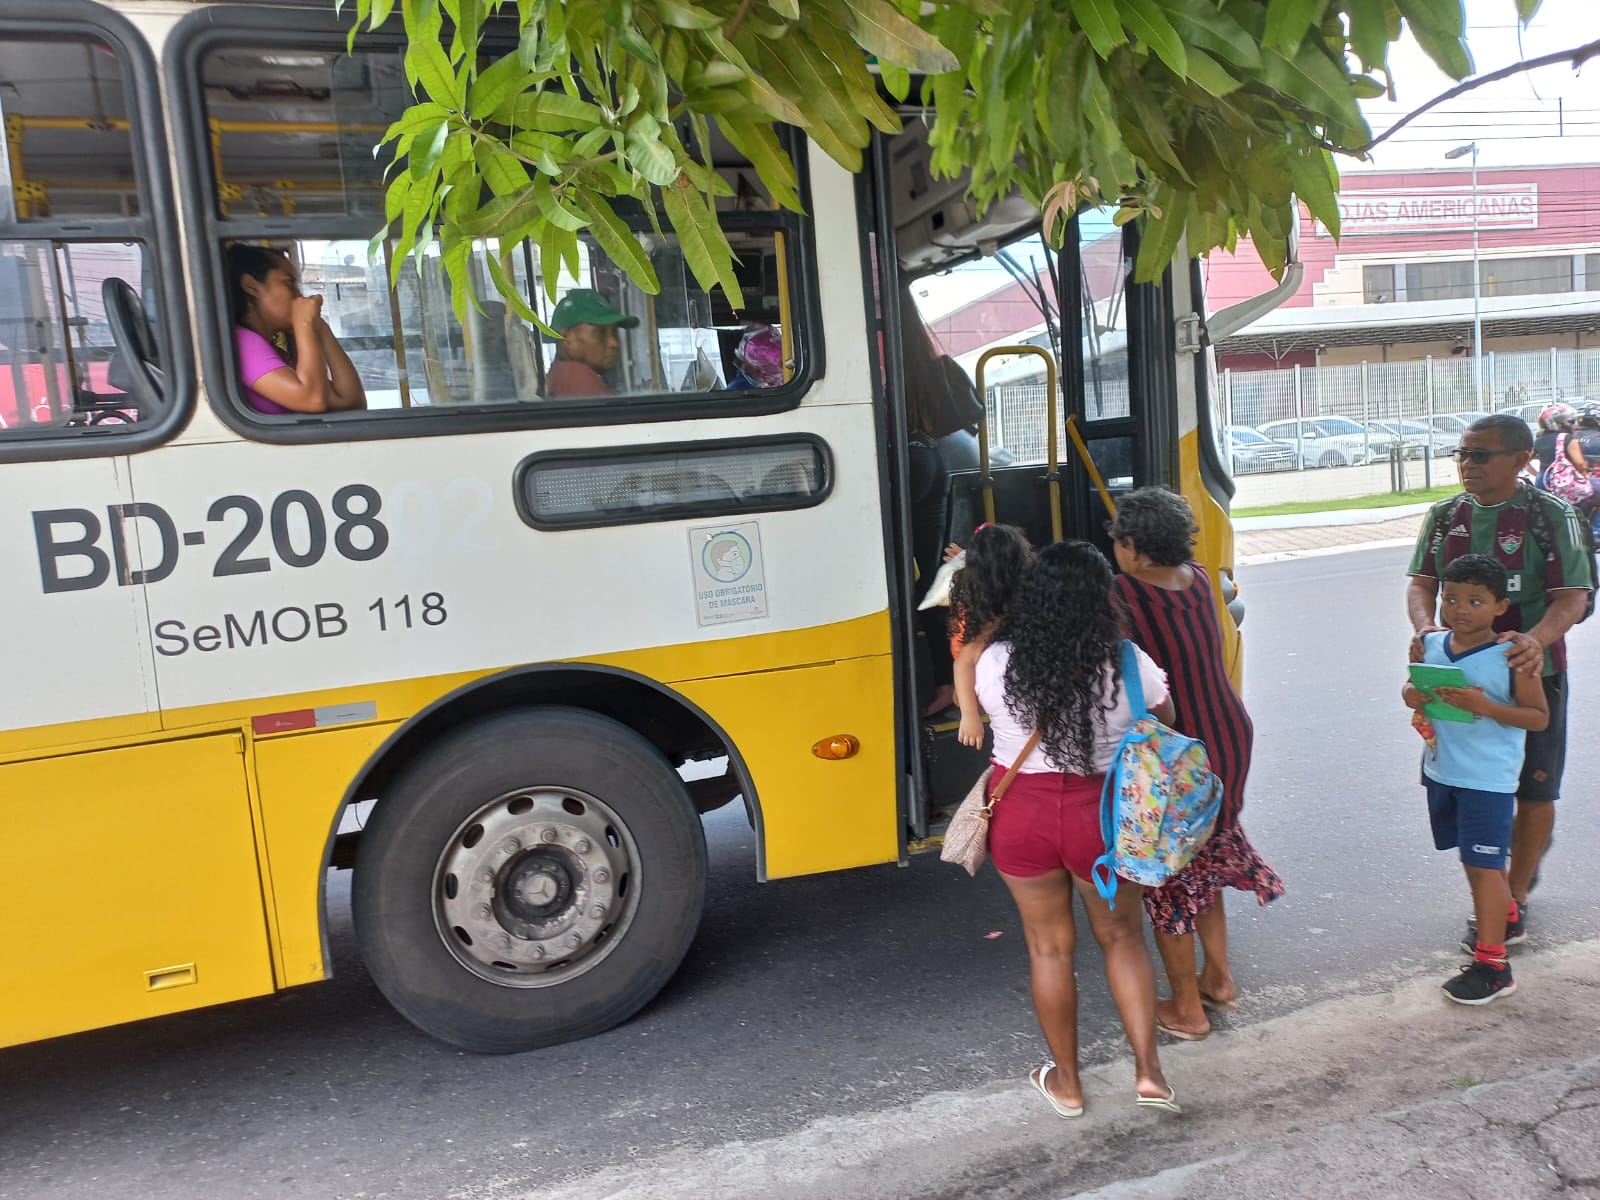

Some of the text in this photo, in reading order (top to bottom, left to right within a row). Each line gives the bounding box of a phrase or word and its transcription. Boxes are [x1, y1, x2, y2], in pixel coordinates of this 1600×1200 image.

[1340, 197, 1533, 223] OJAS AMERICANAS
[31, 483, 389, 594] BD-208
[698, 590, 713, 600] USO
[709, 600, 719, 609] DE
[155, 591, 448, 656] SeMOB 118
